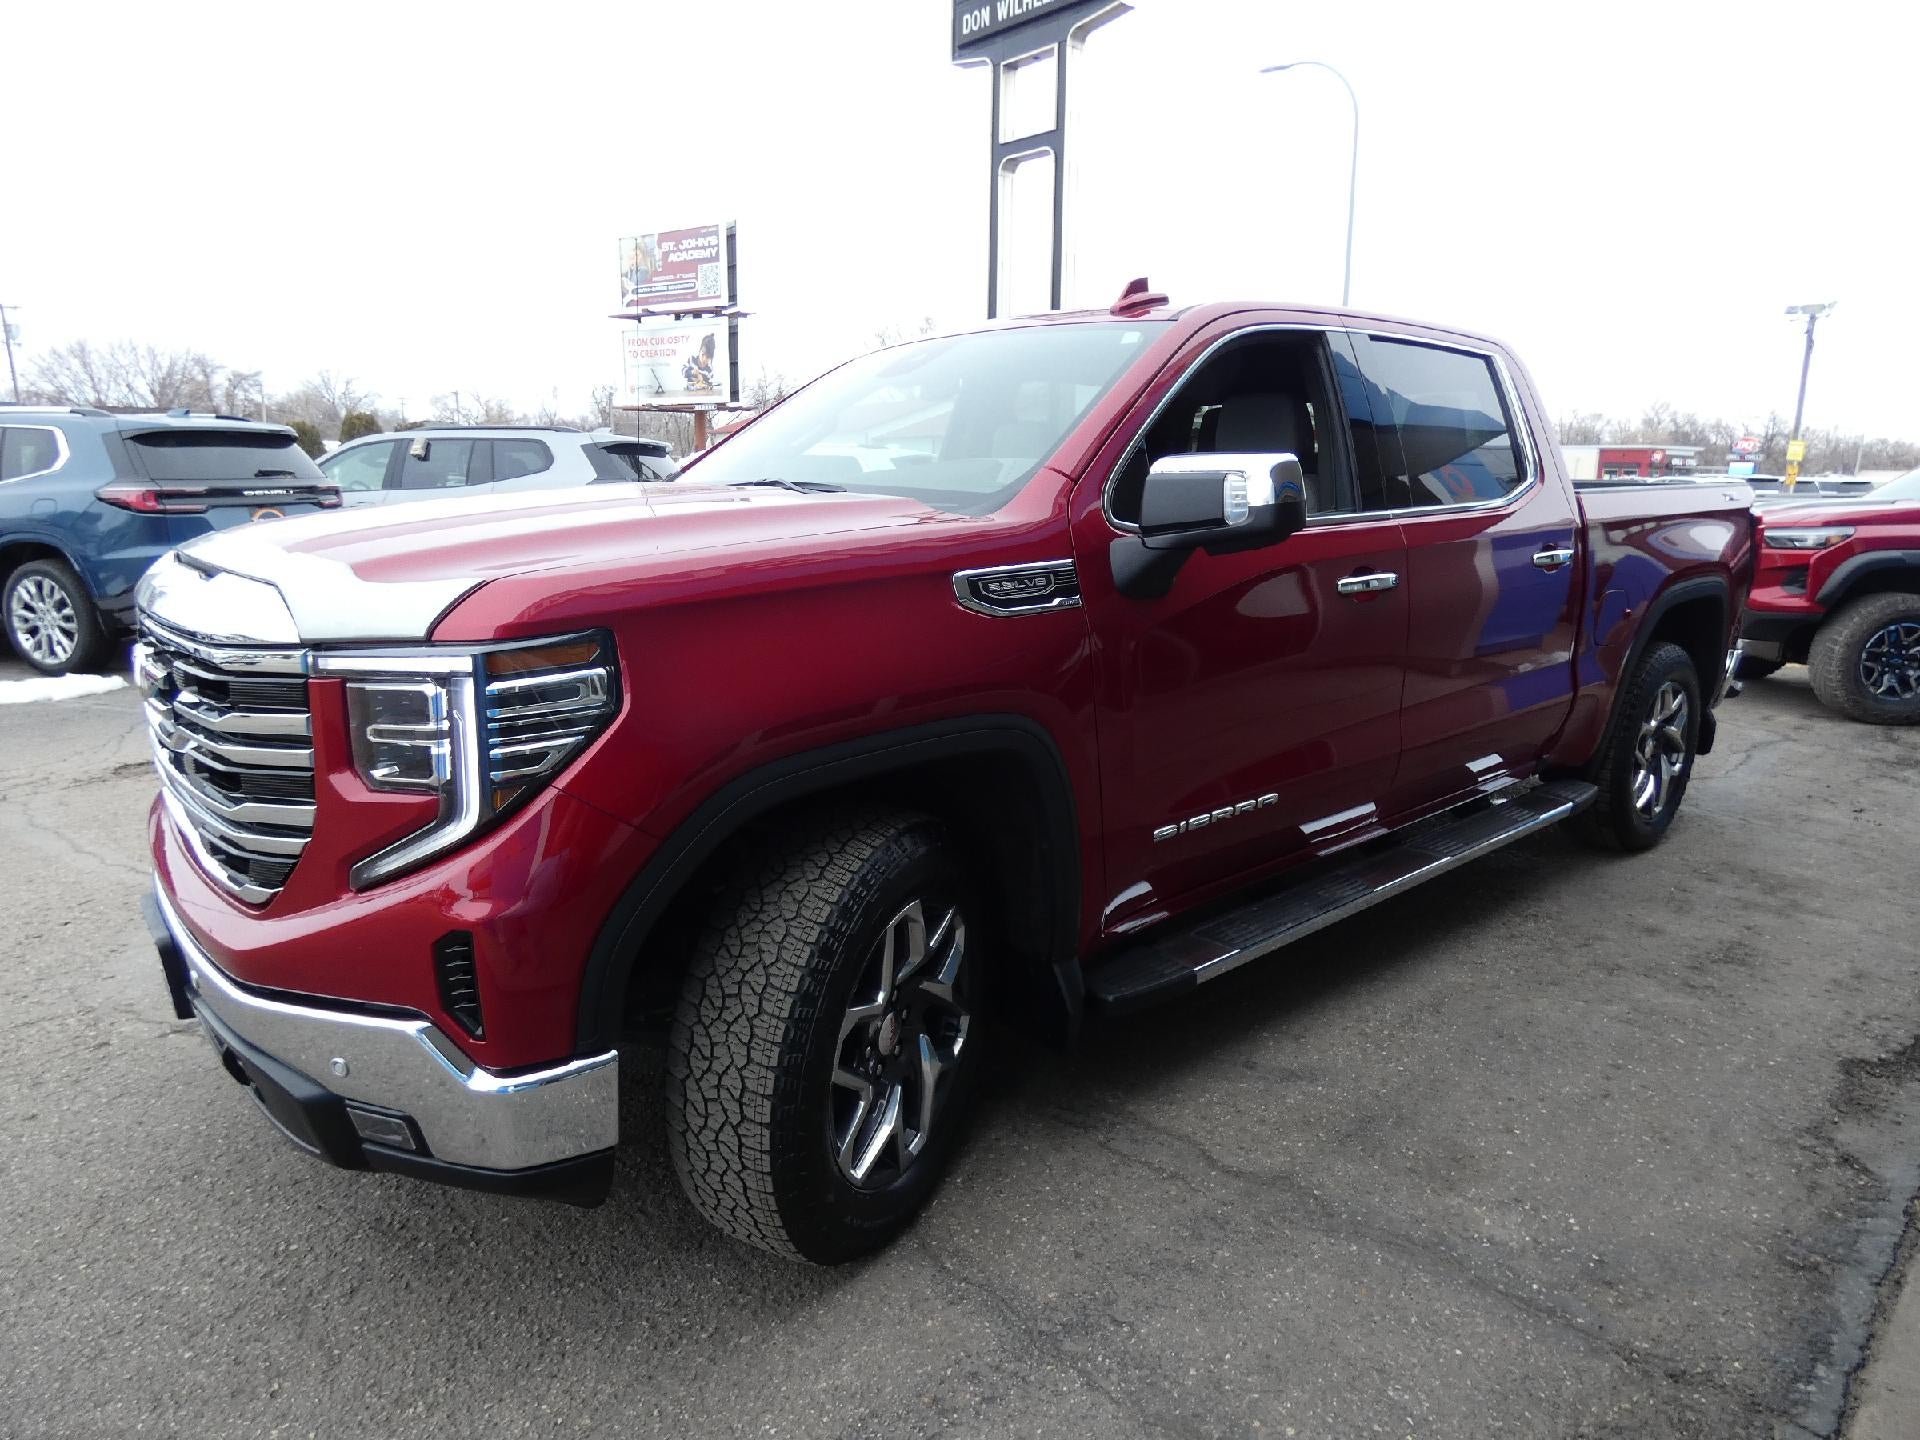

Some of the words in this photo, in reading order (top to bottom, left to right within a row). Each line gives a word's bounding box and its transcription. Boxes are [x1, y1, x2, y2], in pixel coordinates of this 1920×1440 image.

[962, 6, 991, 35] DON
[668, 247, 718, 262] ACADEMY
[628, 337, 649, 347] FROM
[650, 335, 690, 346] CURIOSITY
[628, 350, 639, 359] TO
[640, 348, 677, 359] CREATION
[1153, 792, 1279, 842] SIERRA
